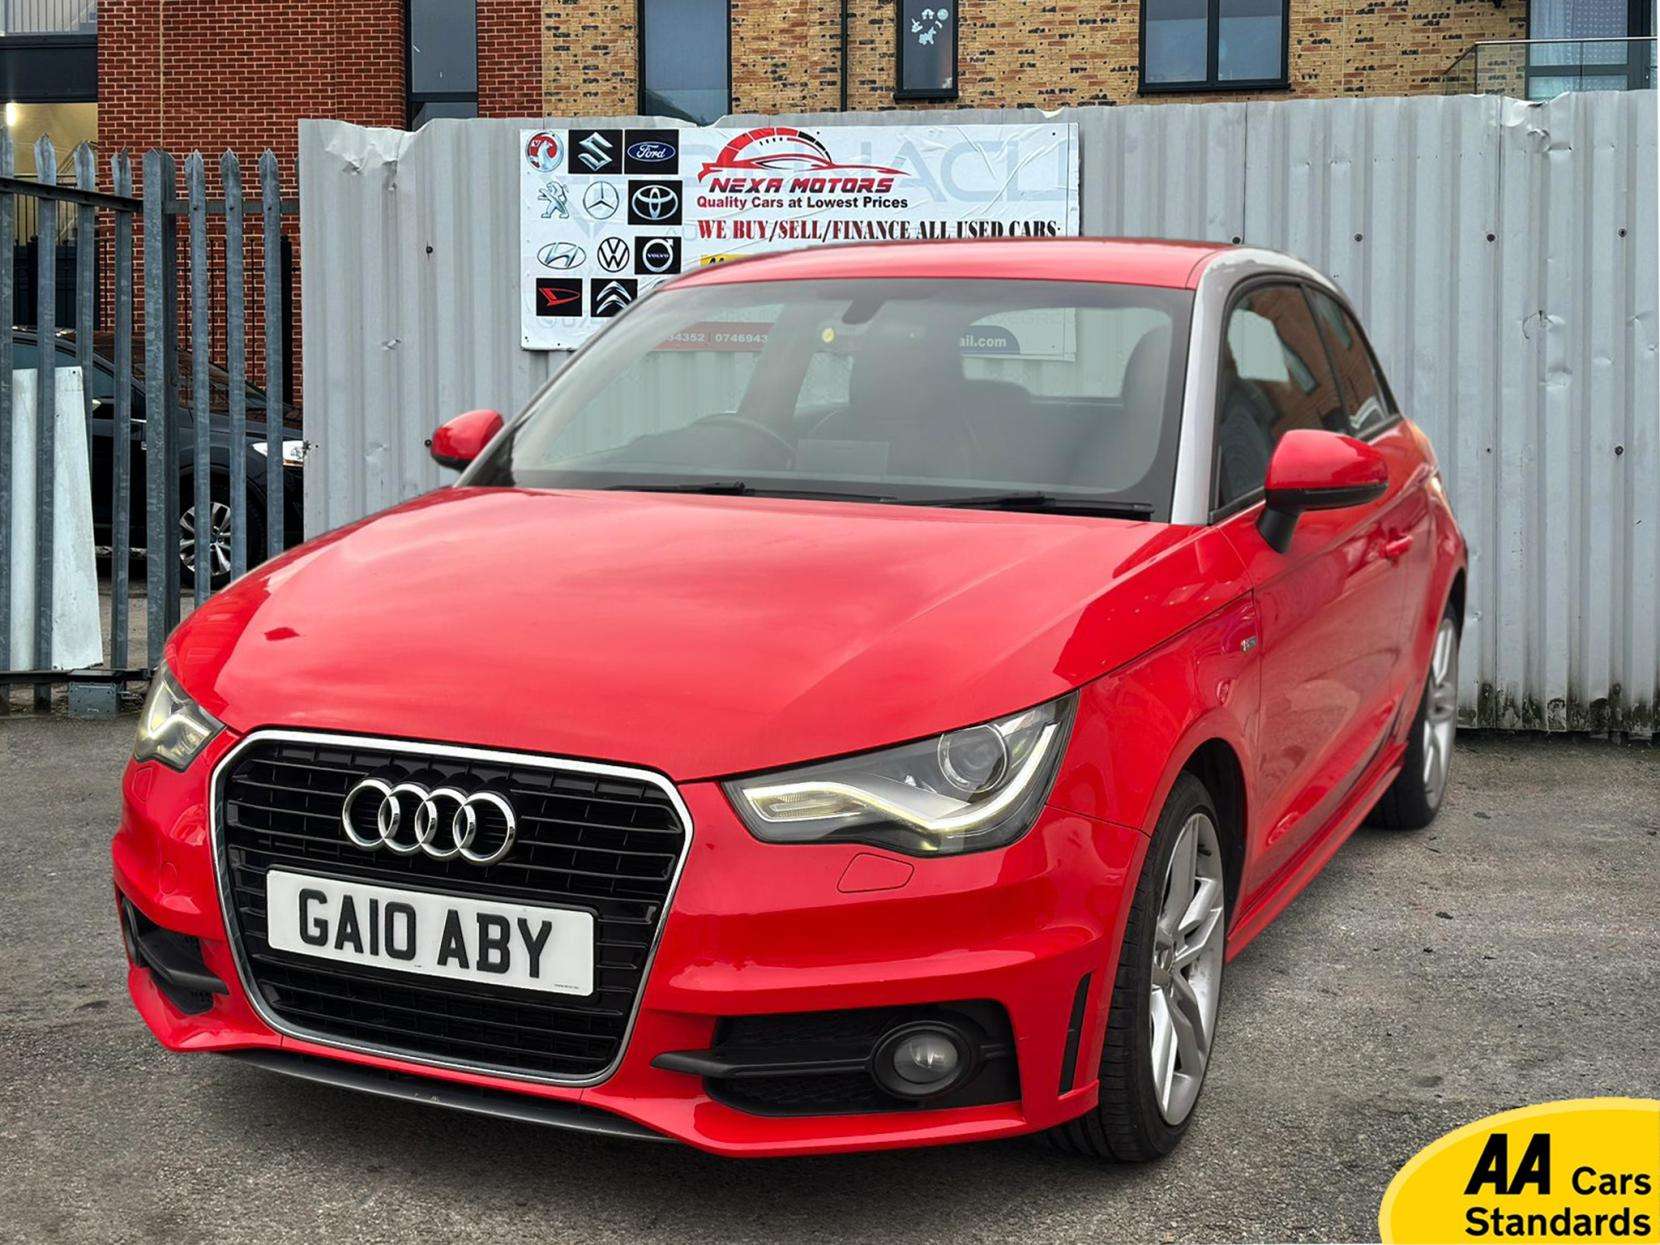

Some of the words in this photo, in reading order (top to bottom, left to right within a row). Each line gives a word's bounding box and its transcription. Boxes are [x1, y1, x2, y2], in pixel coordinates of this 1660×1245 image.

[636, 144, 666, 159] Ford
[709, 178, 784, 193] NEXA
[789, 178, 895, 193] MOTORS
[697, 196, 747, 210] Quality
[752, 196, 784, 208] Cars
[788, 197, 803, 208] at
[807, 196, 859, 208] Lowest
[863, 196, 908, 208] Prices
[697, 220, 727, 240] WE
[916, 220, 950, 240] ALL
[956, 220, 1004, 239] USED
[437, 909, 552, 978] ABY
